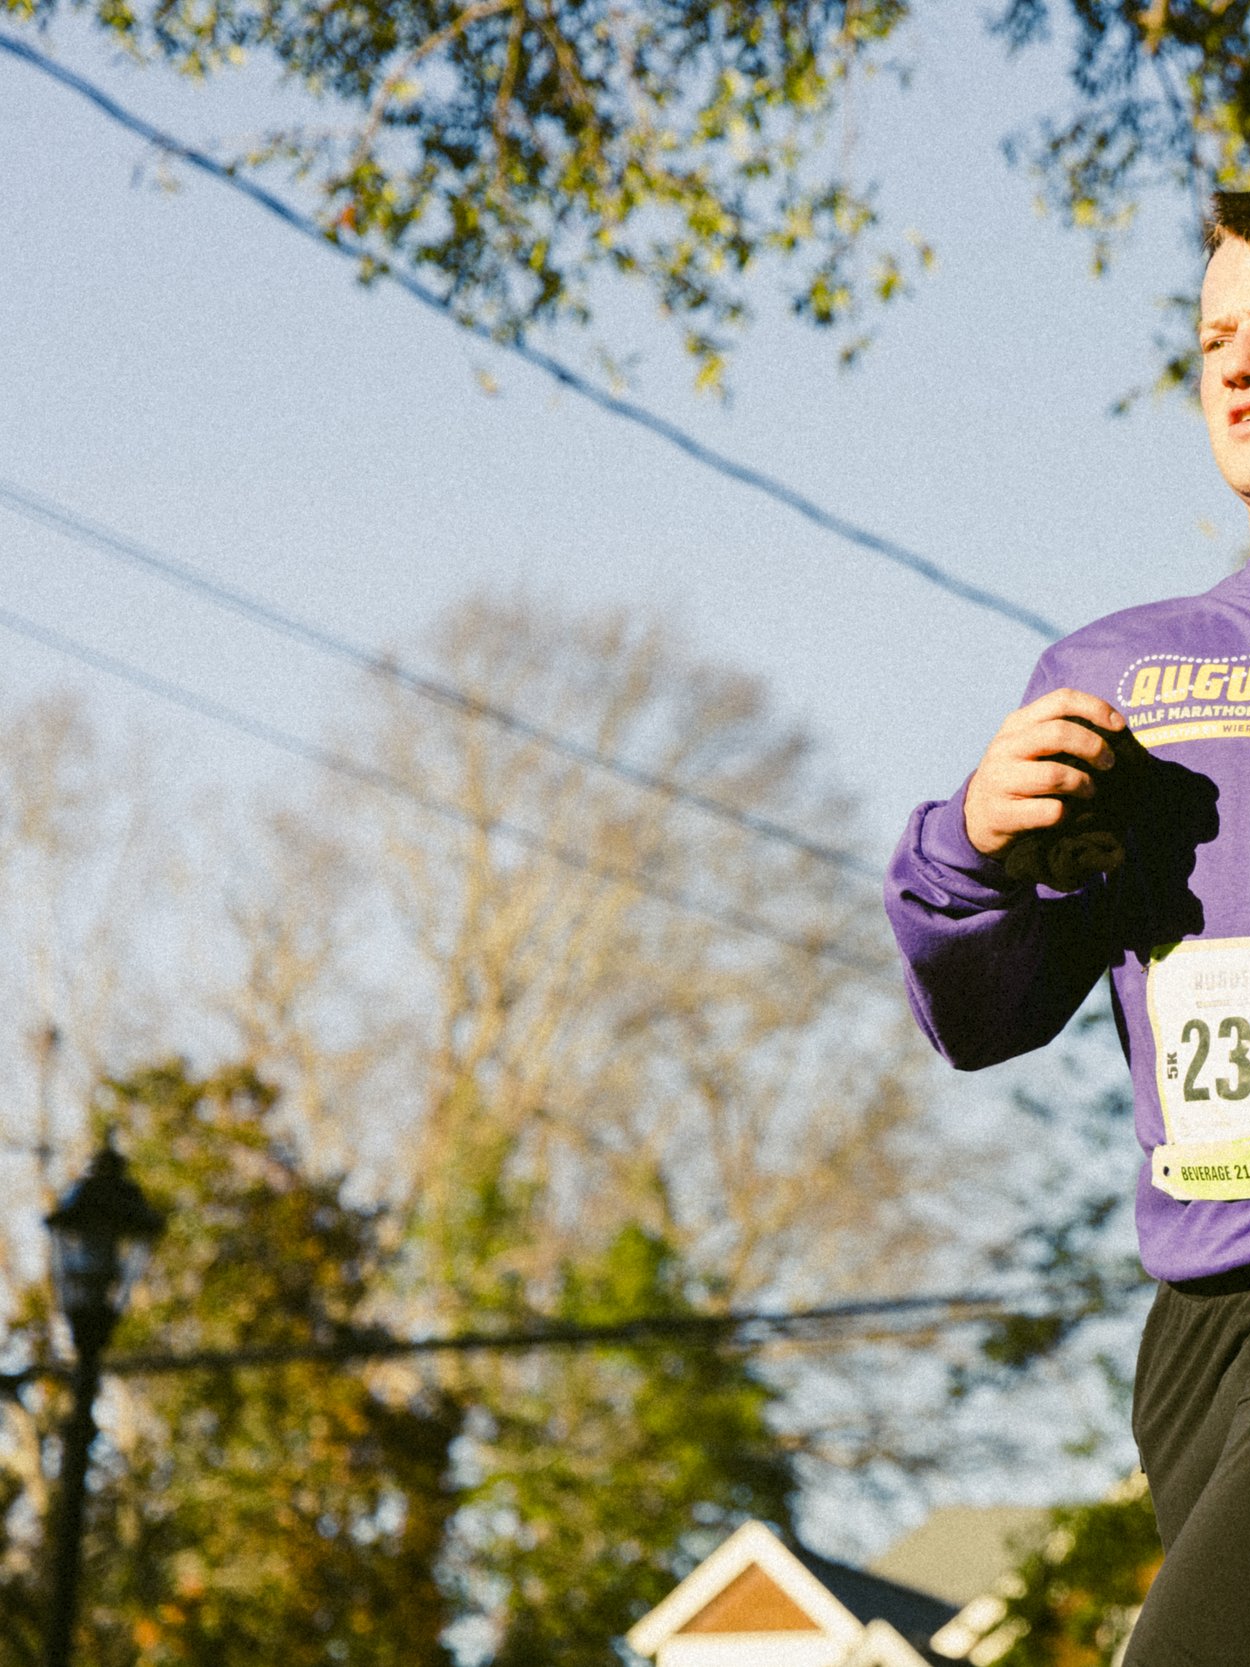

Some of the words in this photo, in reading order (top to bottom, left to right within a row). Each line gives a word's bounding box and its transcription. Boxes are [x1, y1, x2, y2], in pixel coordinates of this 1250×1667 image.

[1129, 709, 1165, 728] HALF
[1167, 1052, 1178, 1079] 5K
[1181, 1165, 1232, 1181] BEVERAGE
